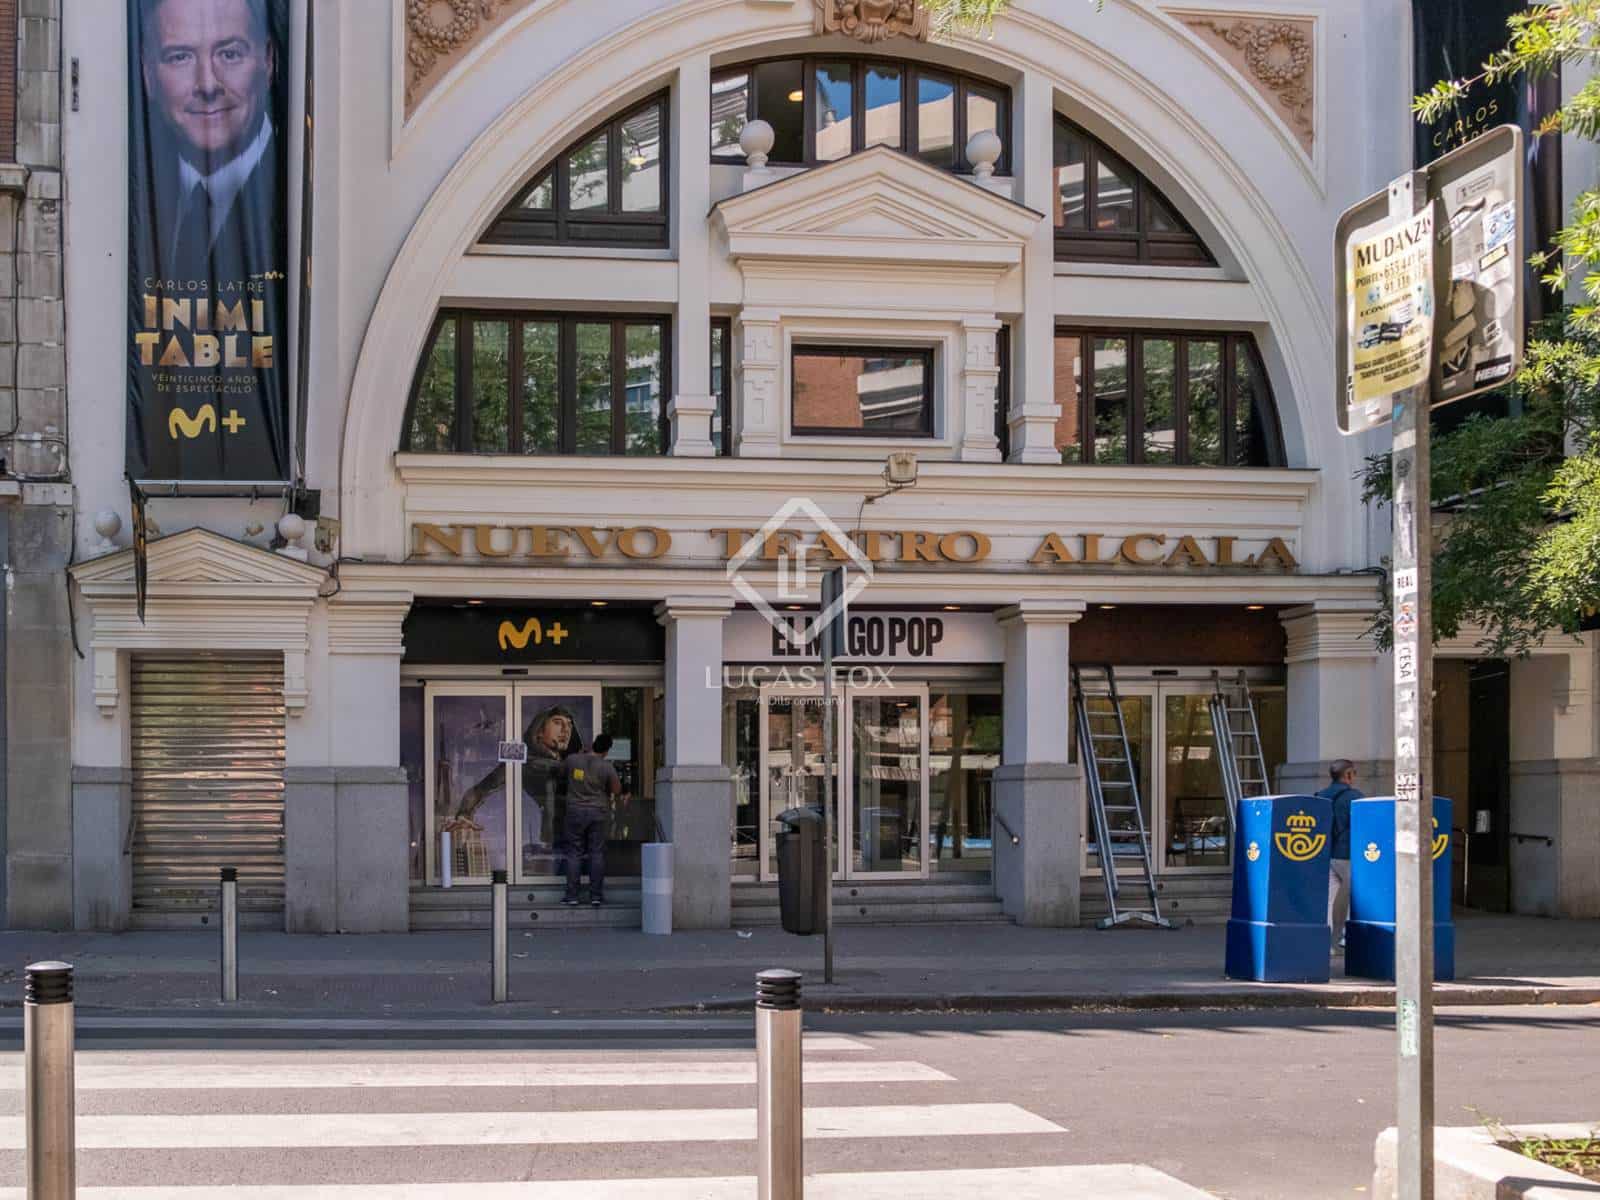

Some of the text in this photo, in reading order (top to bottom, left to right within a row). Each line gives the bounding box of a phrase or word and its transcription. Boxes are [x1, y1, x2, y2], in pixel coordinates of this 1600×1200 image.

[1433, 99, 1498, 146] CARLOS
[144, 277, 265, 293] CARLOS LATRE
[143, 293, 264, 332] INIMI
[135, 331, 273, 368] TABLE
[151, 373, 223, 384] VEINTICINCO
[412, 523, 1299, 568] NUEVO TEATRO ALCALA
[888, 616, 944, 657] POP
